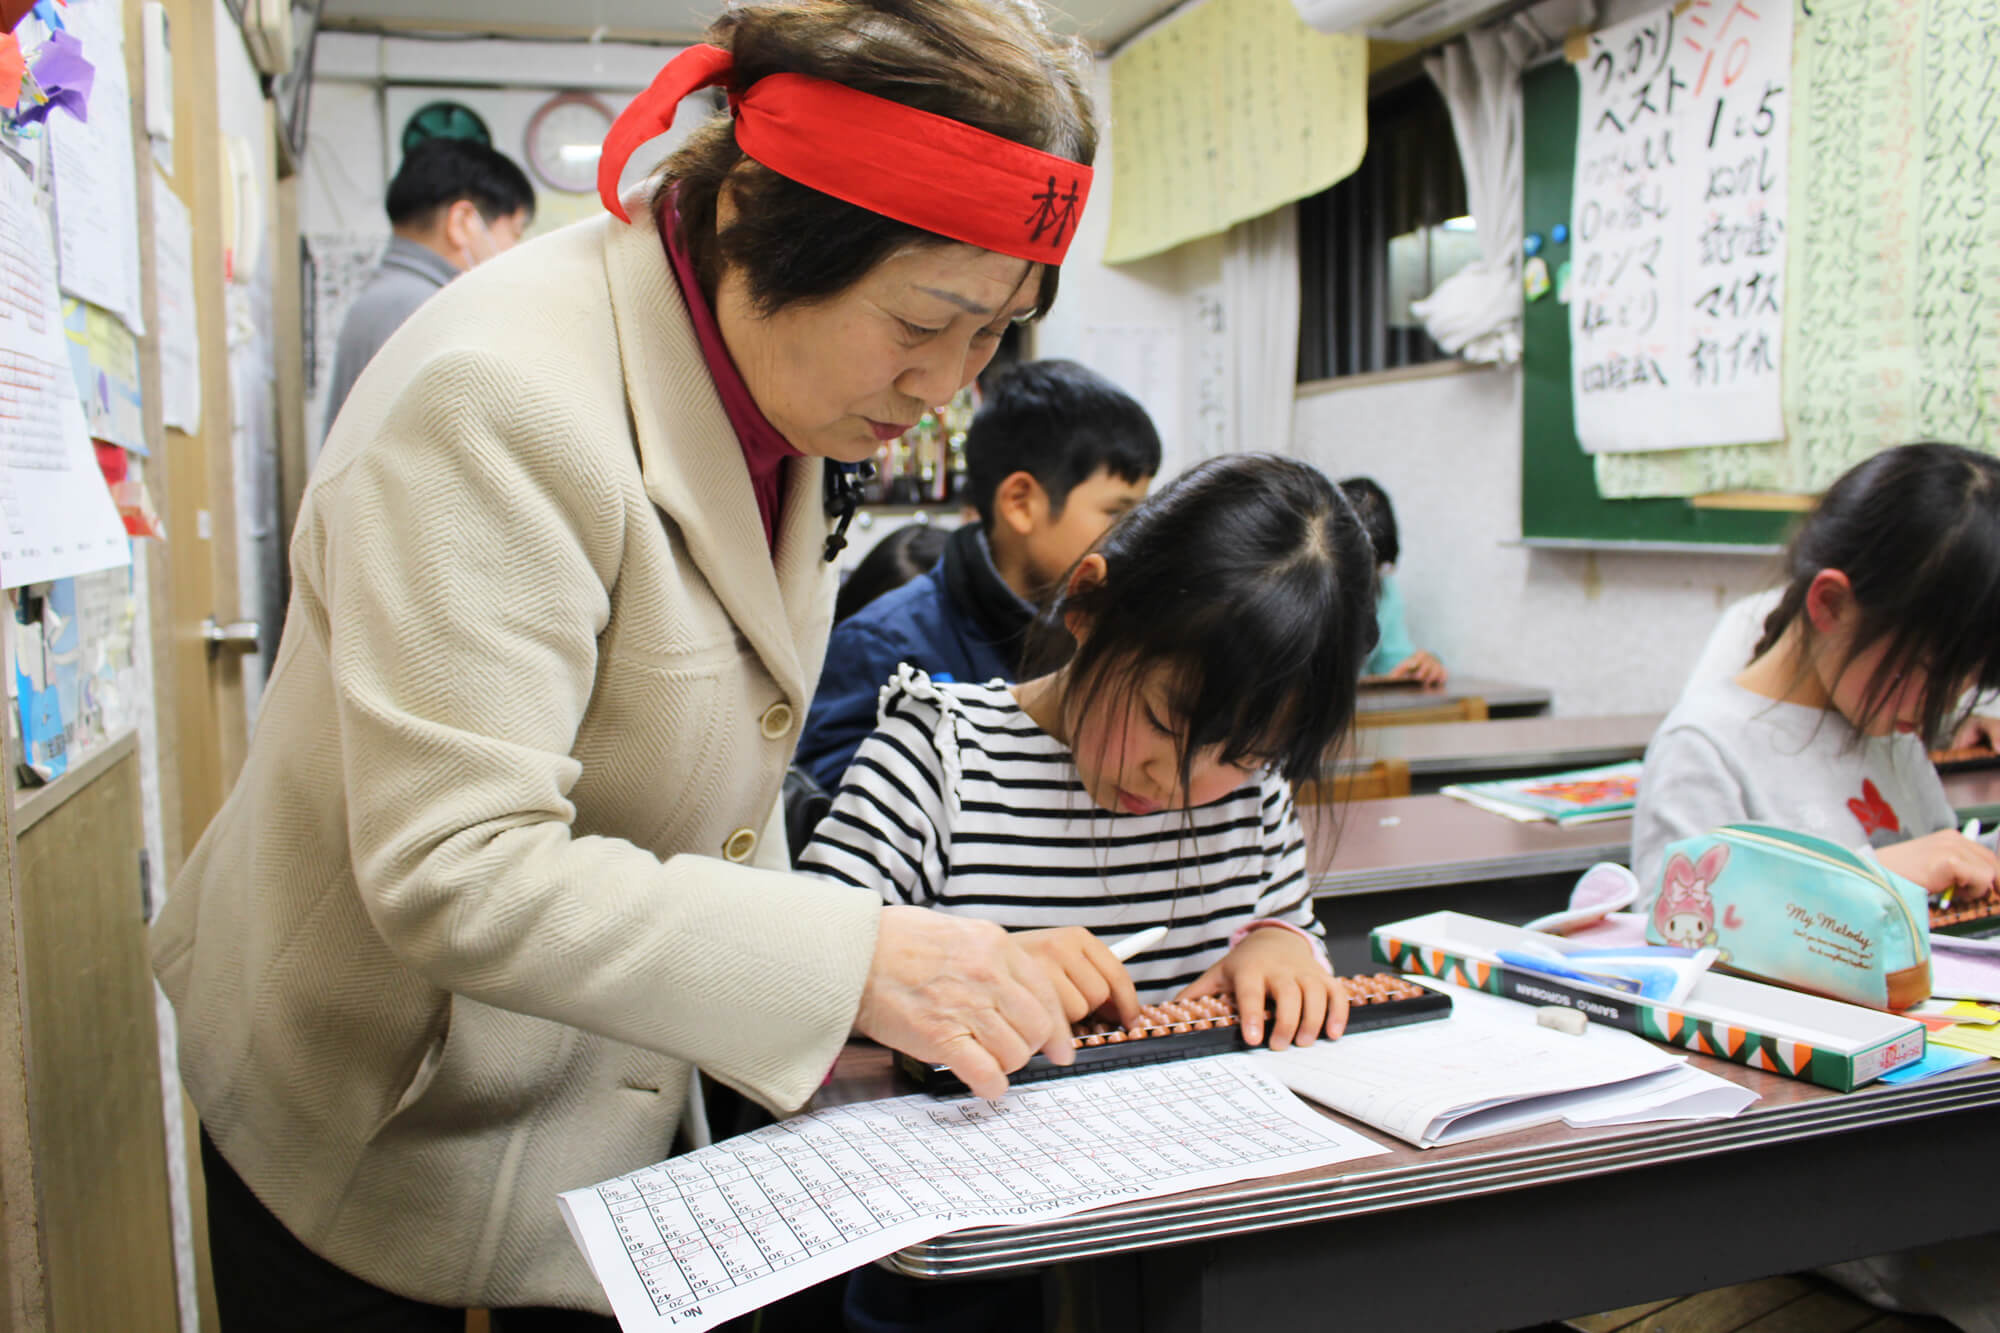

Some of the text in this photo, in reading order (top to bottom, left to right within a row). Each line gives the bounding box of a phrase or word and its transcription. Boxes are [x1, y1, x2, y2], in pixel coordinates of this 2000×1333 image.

[1024, 176, 1079, 248] 林
[1693, 271, 1782, 319] マイナス
[1785, 903, 1815, 929] My
[1816, 911, 1872, 952] Melody
[670, 1306, 702, 1325] No. 1
